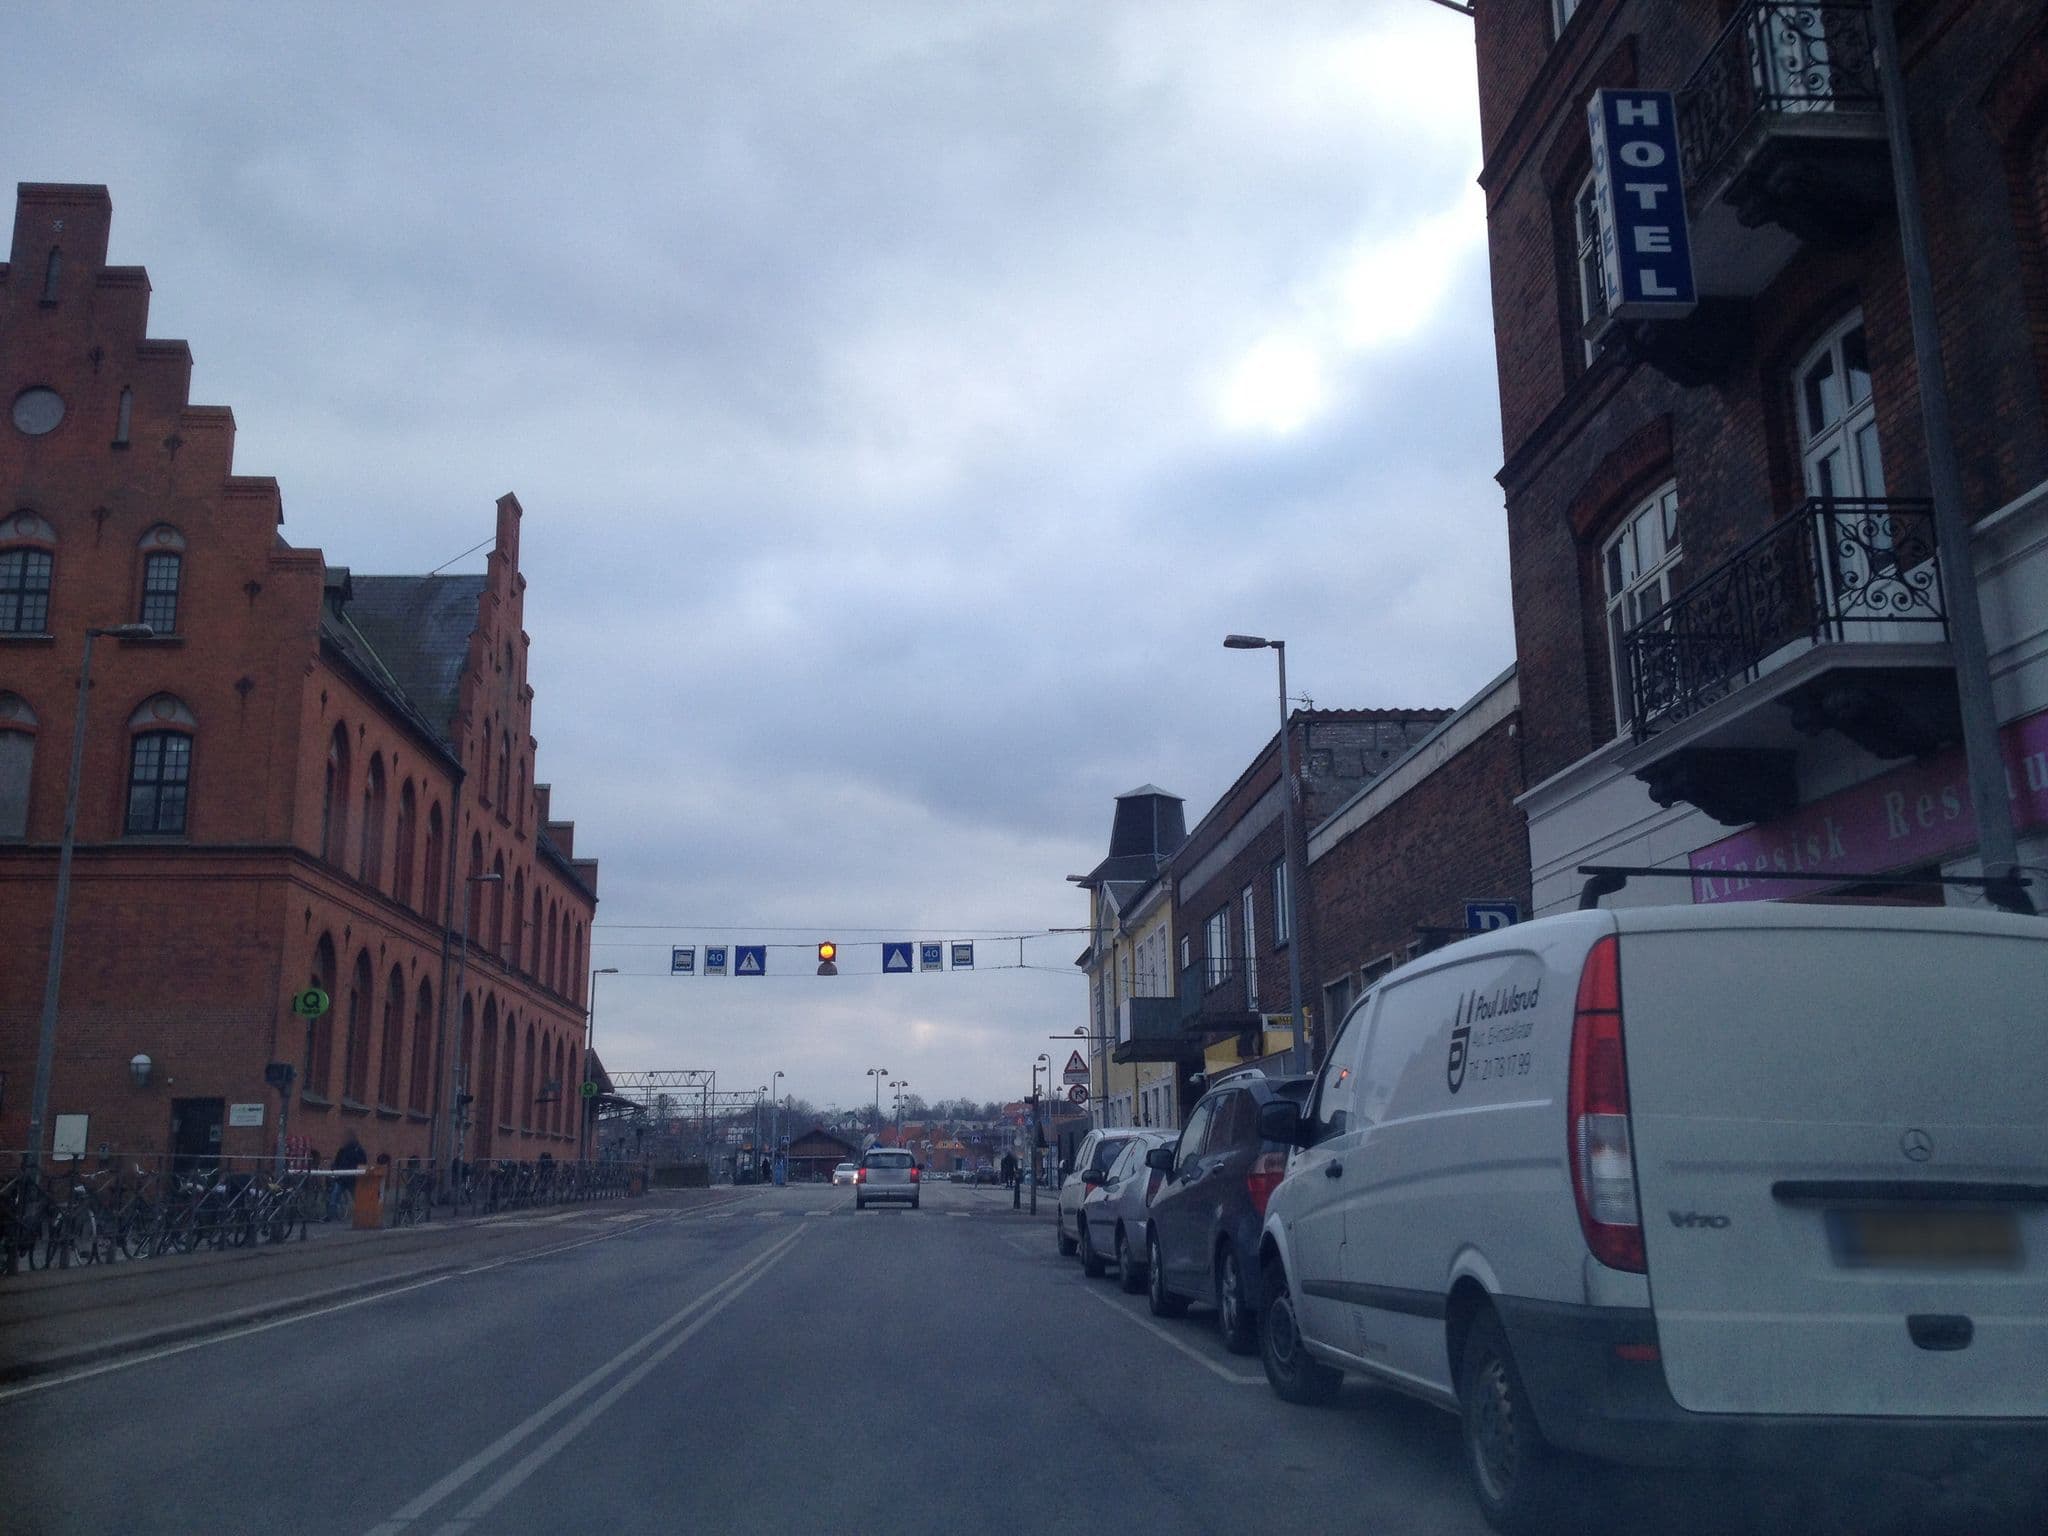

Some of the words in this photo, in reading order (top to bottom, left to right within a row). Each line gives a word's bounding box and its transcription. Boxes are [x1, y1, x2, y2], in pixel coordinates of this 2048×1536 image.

[1616, 99, 1677, 296] HOTEL
[1697, 815, 1847, 903] Kinesisk
[708, 953, 723, 962] 40
[925, 949, 938, 958] 40
[303, 991, 320, 1008] Q
